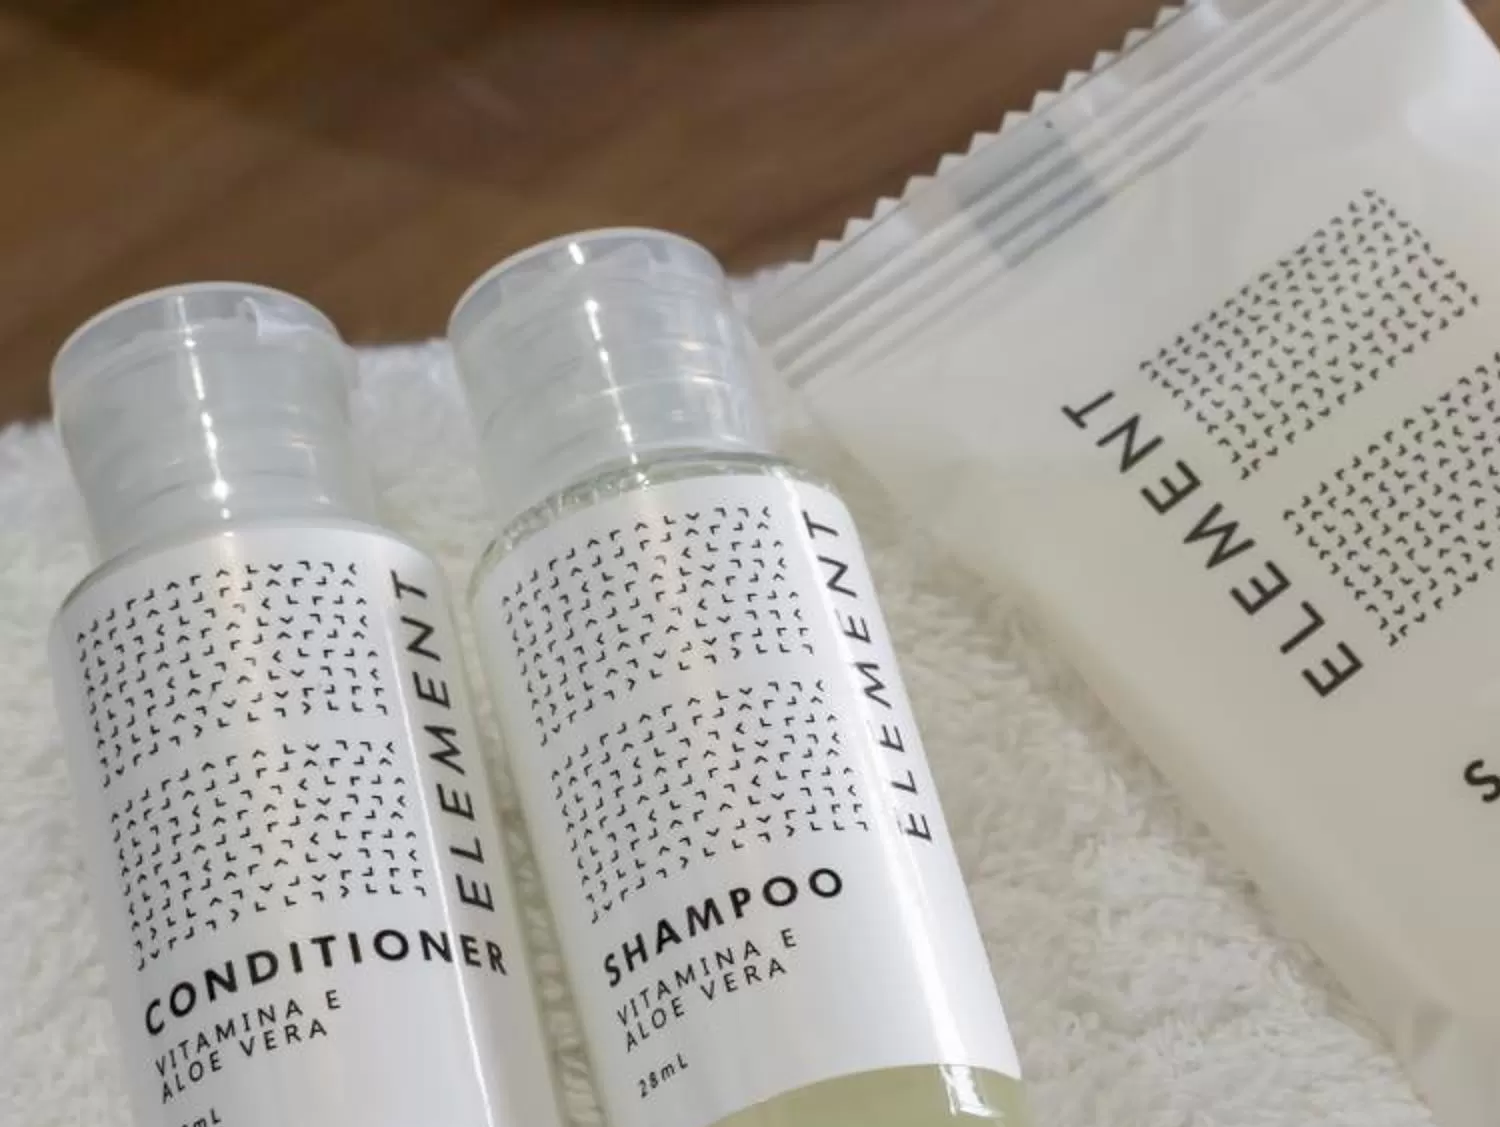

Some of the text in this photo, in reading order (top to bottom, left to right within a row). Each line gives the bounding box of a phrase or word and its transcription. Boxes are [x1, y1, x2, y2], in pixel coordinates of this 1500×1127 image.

[1061, 389, 1364, 698] ELEMENT
[802, 509, 933, 845] ELEMENT
[390, 569, 496, 914] ELEMENT
[603, 867, 844, 988] SHAMPOO
[615, 927, 798, 1027] VITAMINA E
[144, 928, 507, 1037] CONDITIONER
[154, 989, 342, 1077] VITAMINA E
[623, 958, 788, 1053] ALOE VERA
[161, 1018, 328, 1104] ALOE VERA
[637, 1054, 690, 1099] 28mL
